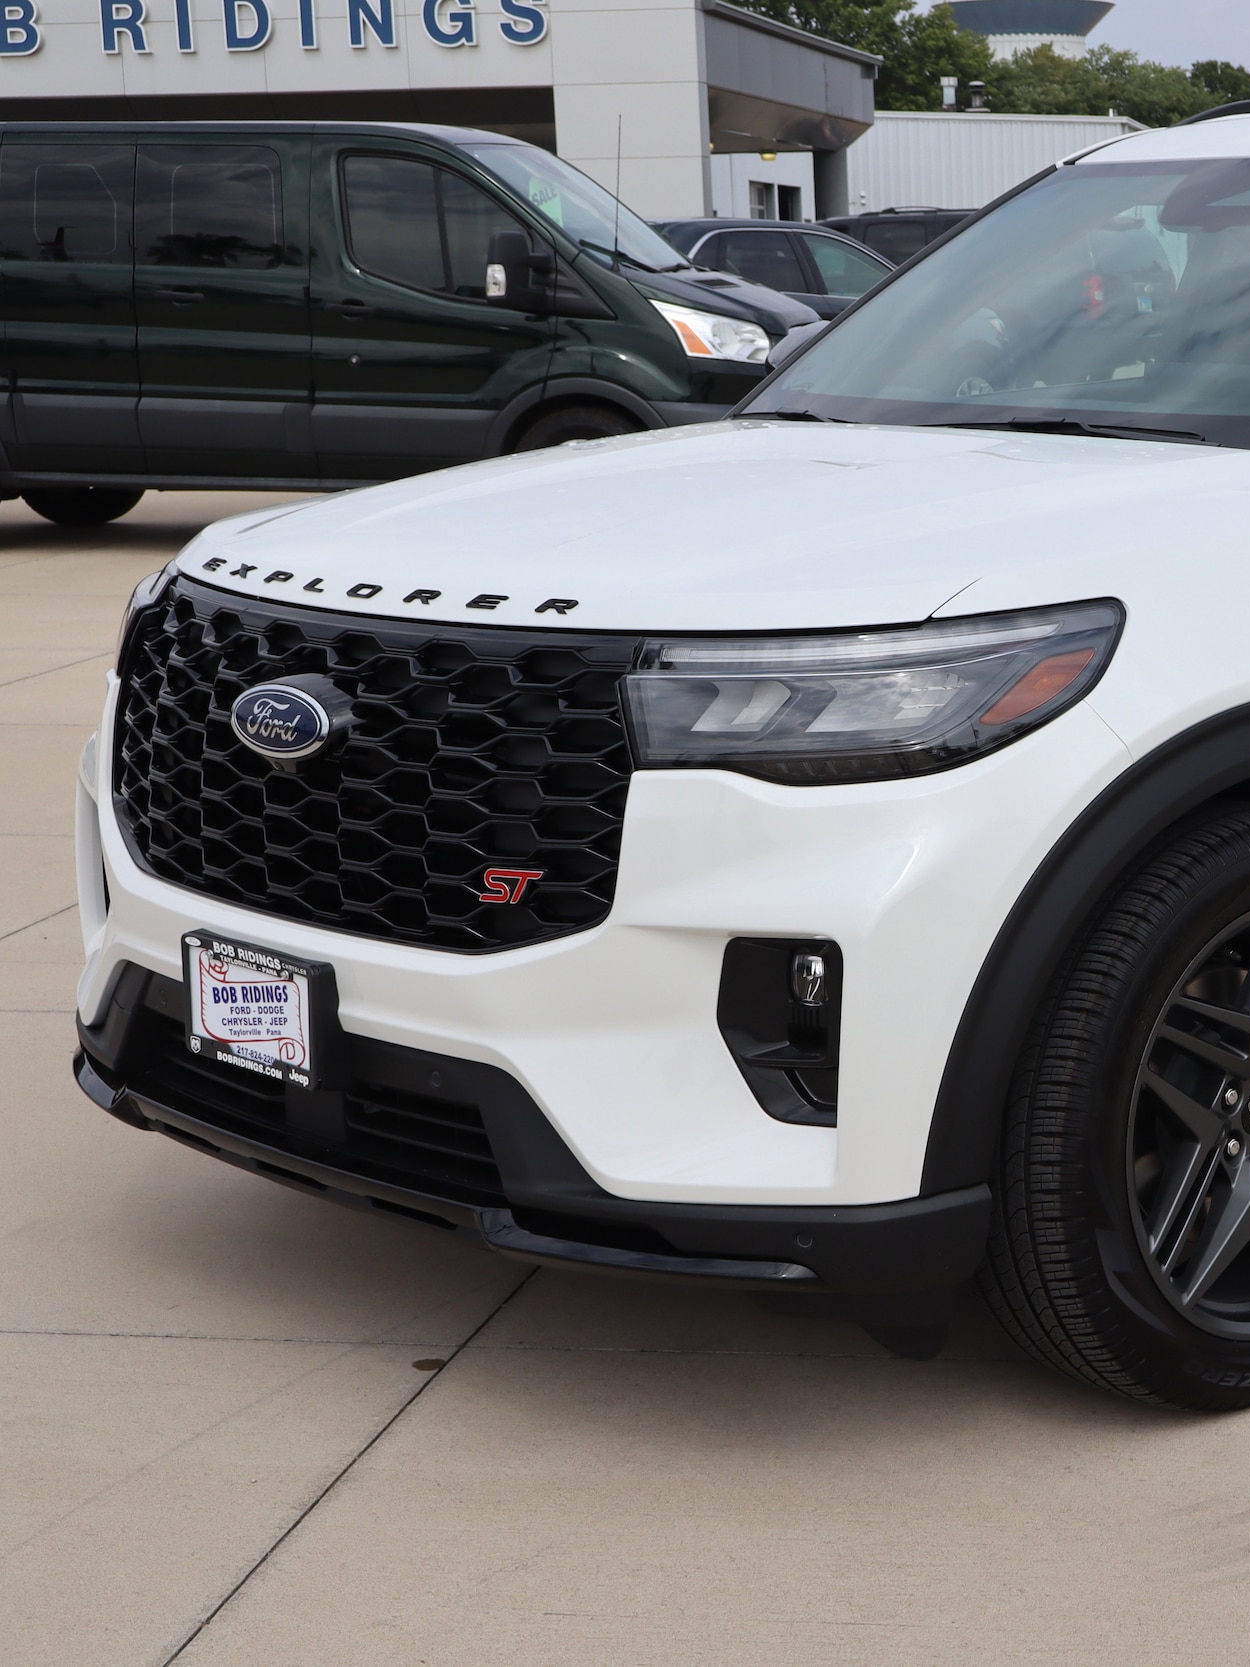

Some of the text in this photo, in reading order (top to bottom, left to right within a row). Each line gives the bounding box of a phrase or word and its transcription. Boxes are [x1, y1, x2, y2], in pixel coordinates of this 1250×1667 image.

[100, 0, 548, 55] RIDINGS
[531, 186, 558, 206] SALE
[202, 557, 579, 615] EXPLORER
[246, 698, 302, 742] Ford
[479, 868, 544, 904] ST
[212, 941, 235, 957] BOB
[237, 948, 281, 970] RIDINGS
[282, 963, 307, 976] CHRYSLER
[219, 955, 257, 971] TAYLORVILLE
[262, 967, 278, 977] PANA
[212, 985, 288, 1004] BOB RIDINGS
[222, 1017, 263, 1026] CHRYSLER
[269, 1017, 288, 1026] JEEP
[230, 1006, 251, 1015] FORD
[258, 1006, 284, 1015] DODGE
[229, 1028, 282, 1037] Taylorville Pana
[216, 1051, 283, 1080] BOBRIDINGS.COM
[289, 1069, 309, 1087] Jeep
